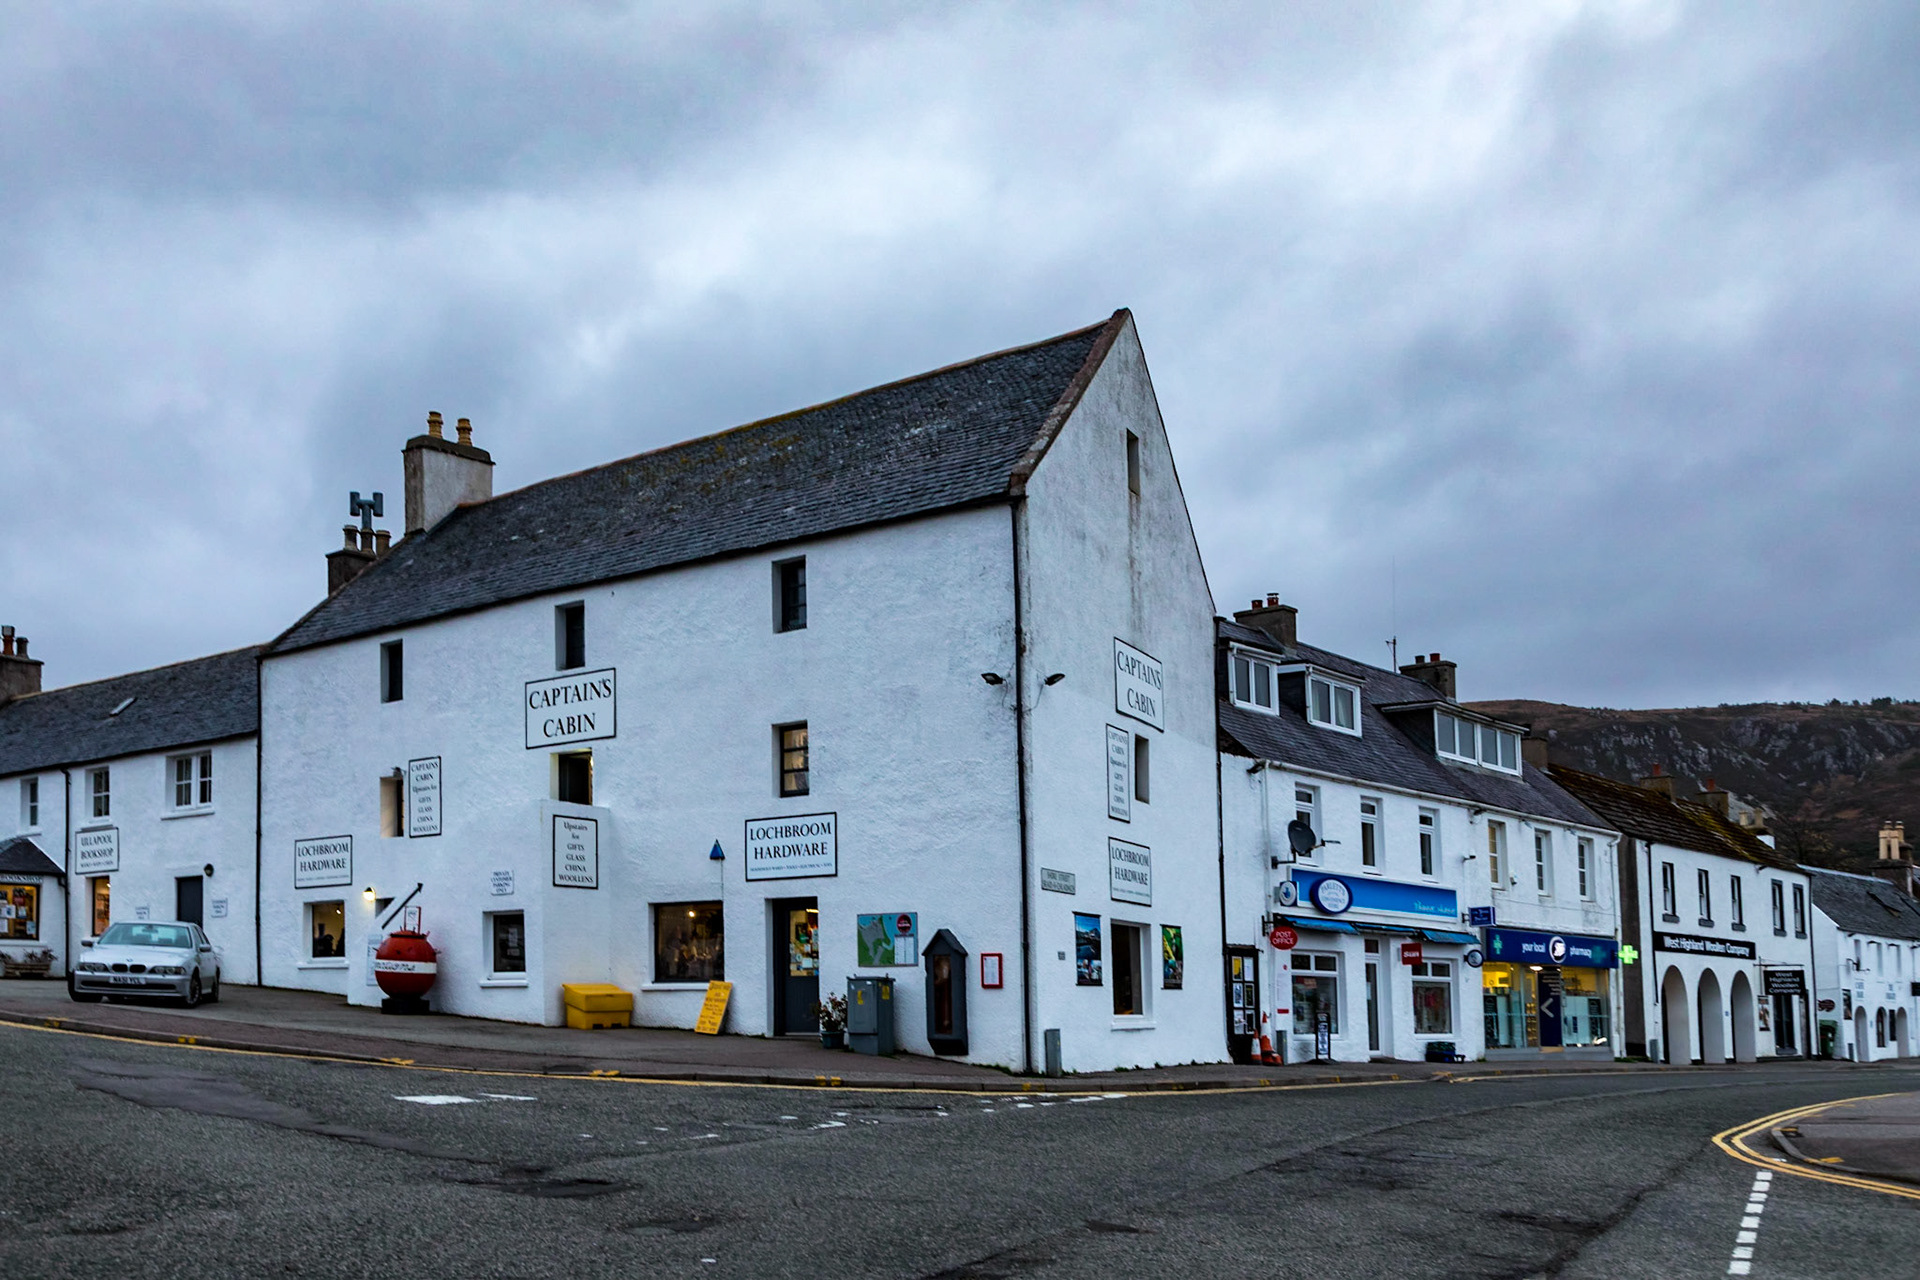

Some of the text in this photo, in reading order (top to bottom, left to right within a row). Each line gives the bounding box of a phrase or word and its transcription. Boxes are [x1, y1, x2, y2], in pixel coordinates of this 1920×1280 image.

[1127, 688, 1156, 718] CABIN
[543, 712, 596, 738] CABIN
[415, 773, 434, 782] CABIN
[417, 806, 433, 814] GLASS
[563, 821, 588, 832] Upstairs
[750, 822, 832, 841] LOCHBROOM
[81, 834, 112, 847] ULLAPOOL
[571, 832, 580, 840] for
[297, 842, 349, 858] LOCHBROOM
[567, 843, 585, 851] GIFTS
[754, 841, 828, 860] HARDWARE
[81, 848, 114, 860] BOOKSHOP
[565, 853, 586, 862] GLASS
[1111, 846, 1150, 868] LOCHBROOM
[300, 858, 347, 872] HARDWARE
[564, 864, 587, 873] CHINA
[559, 874, 594, 884] WOOLLENS
[1114, 866, 1148, 886] HARDWARE
[1272, 937, 1295, 945] OFFICE
[1663, 935, 1750, 957] West Highland Woollen Company
[1522, 943, 1534, 953] your
[1534, 942, 1546, 953] local
[1569, 945, 1592, 959] pharmacy
